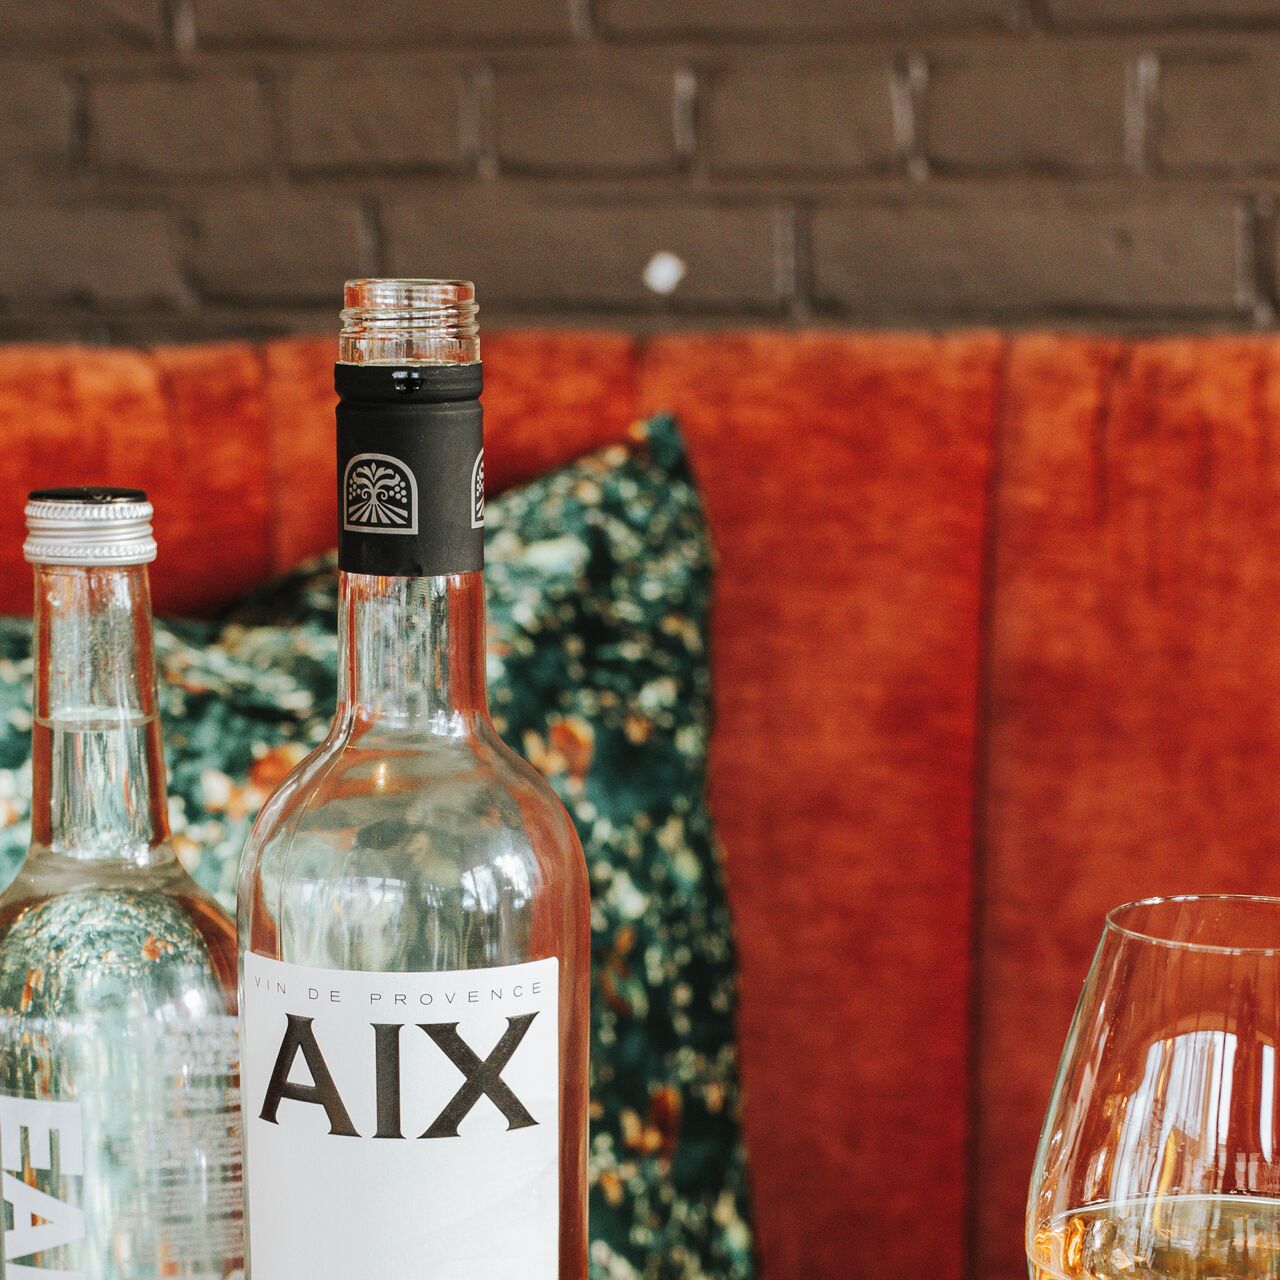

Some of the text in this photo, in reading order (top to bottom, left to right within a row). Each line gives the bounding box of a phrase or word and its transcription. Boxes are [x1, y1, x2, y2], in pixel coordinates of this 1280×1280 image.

[254, 975, 542, 1006] VIN DE PROVENCE
[258, 1010, 542, 1140] AIX
